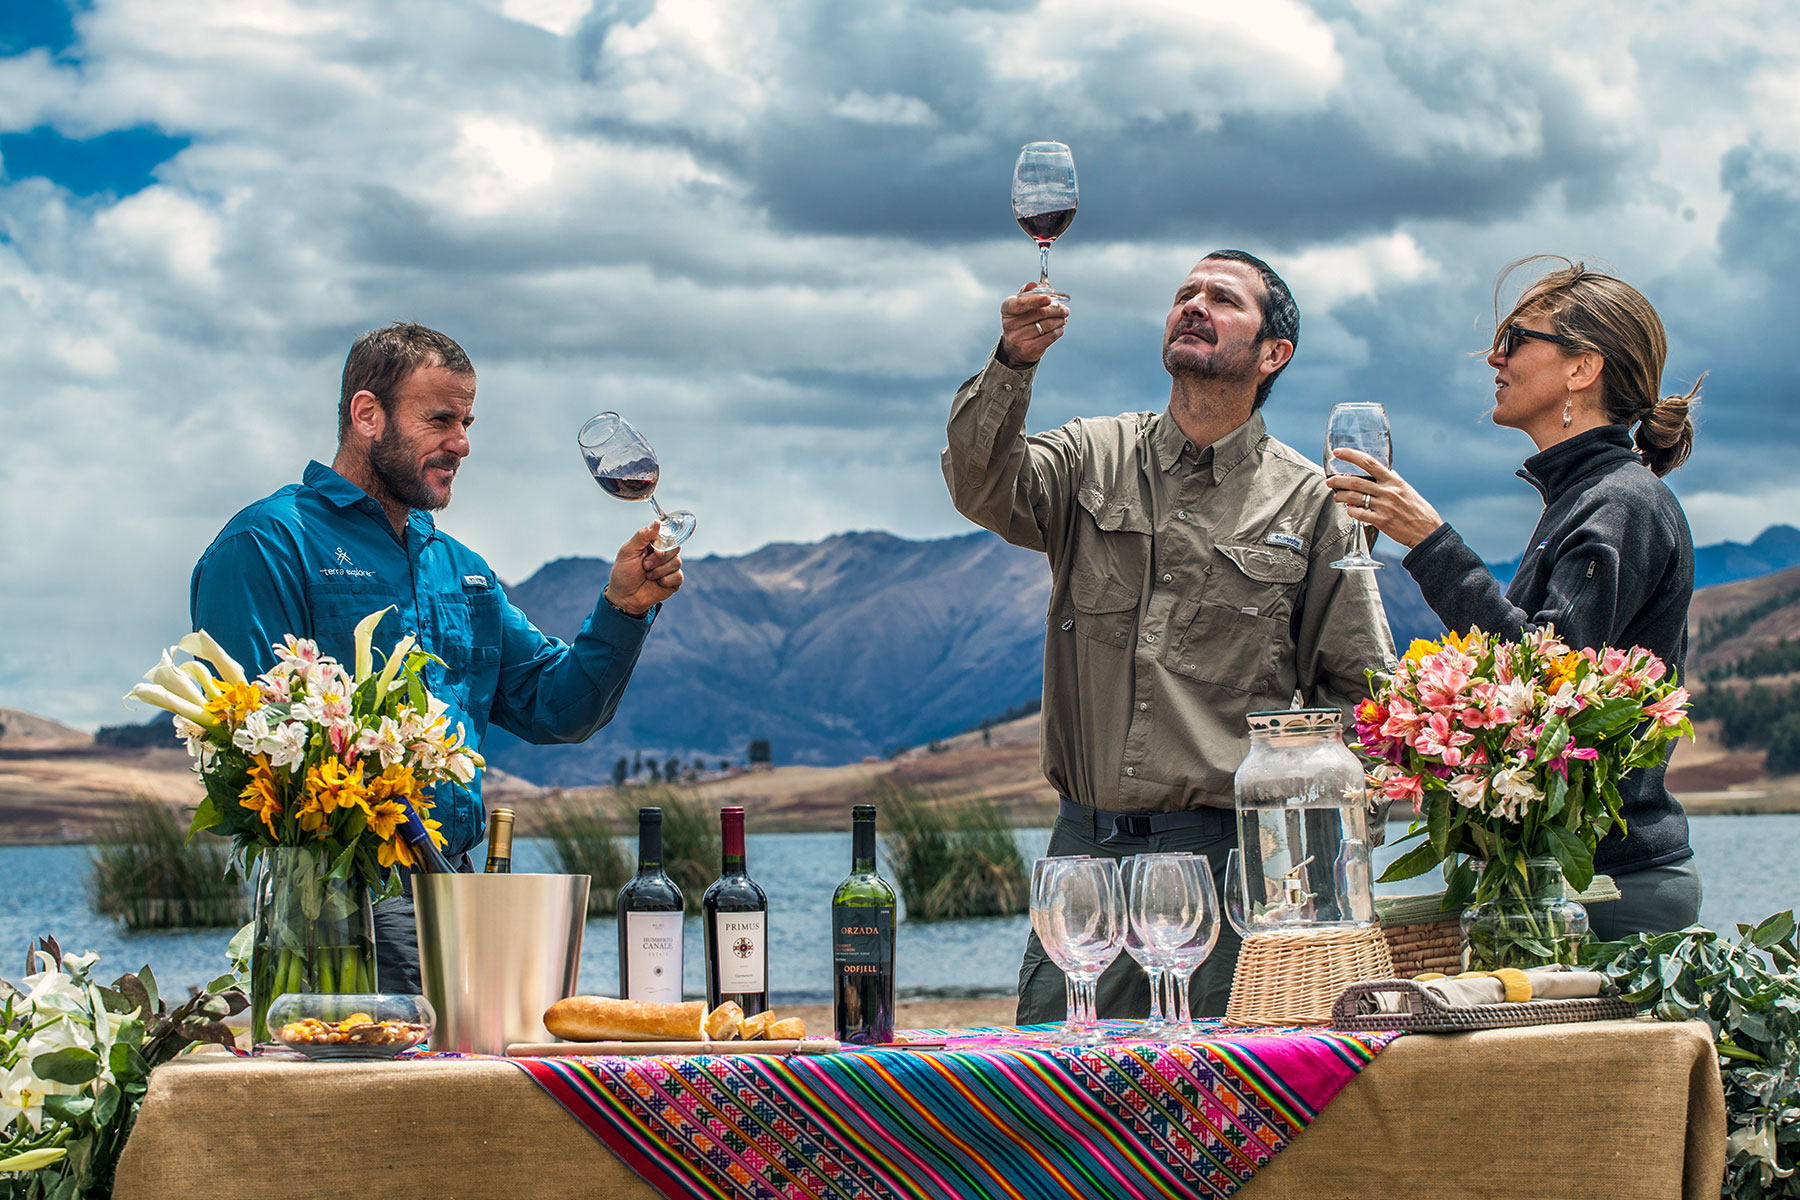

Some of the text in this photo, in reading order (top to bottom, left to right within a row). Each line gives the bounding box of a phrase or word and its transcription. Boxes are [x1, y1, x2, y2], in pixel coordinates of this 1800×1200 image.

[320, 568, 344, 576] terra
[726, 923, 760, 931] PRIMUS
[841, 927, 879, 935] ORZADA
[642, 942, 673, 950] CANALE
[844, 965, 876, 974] ODFJELL
